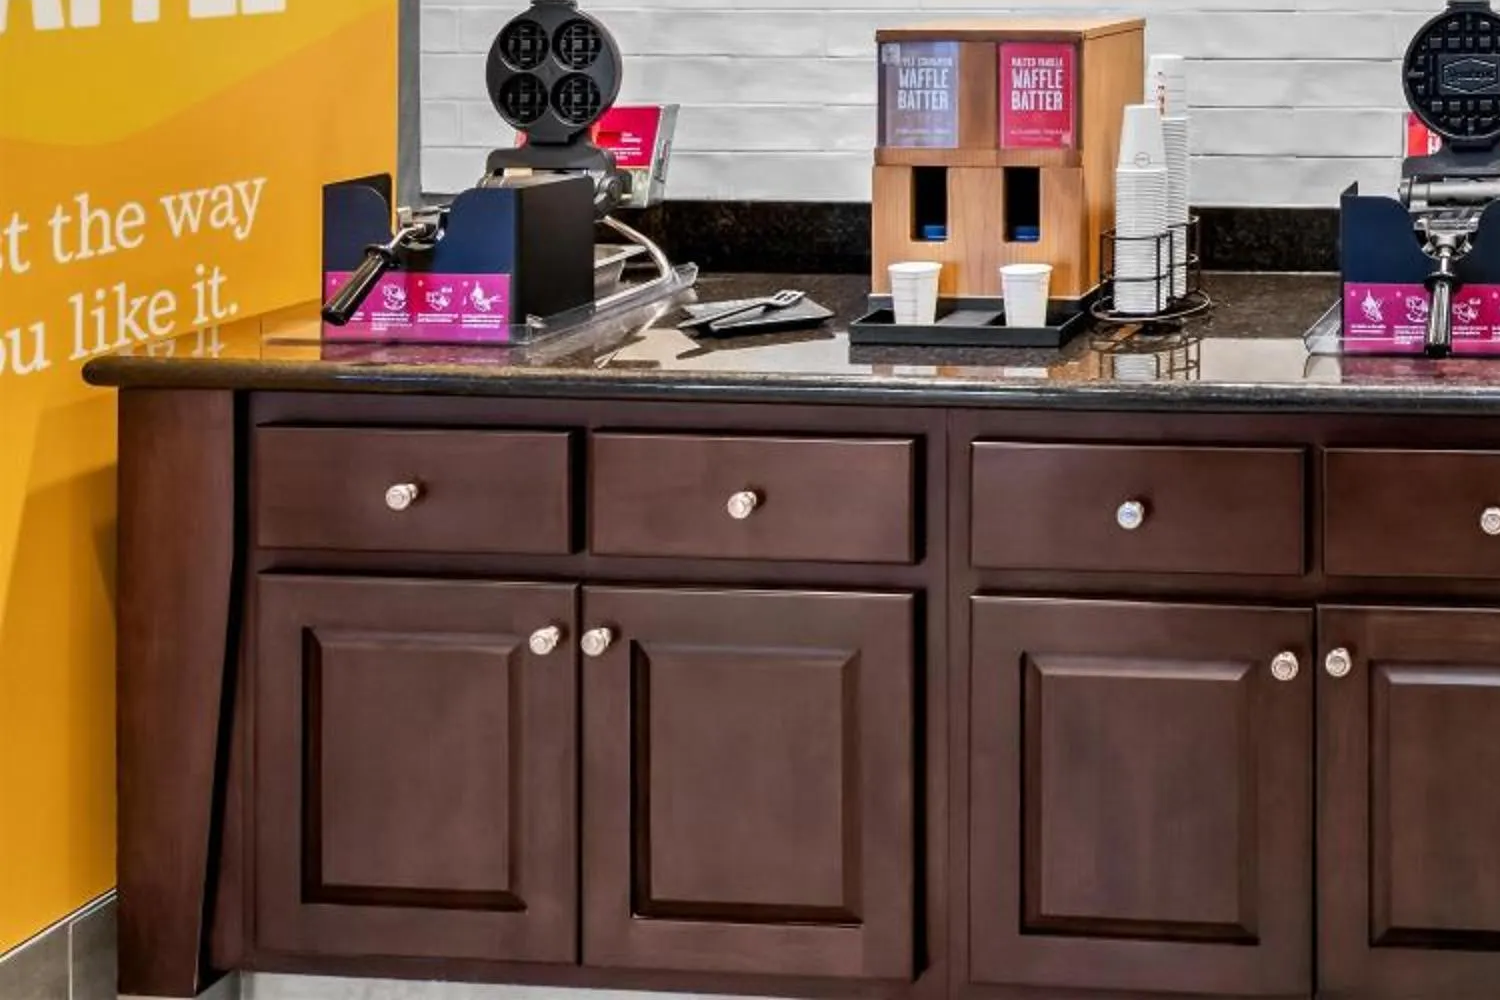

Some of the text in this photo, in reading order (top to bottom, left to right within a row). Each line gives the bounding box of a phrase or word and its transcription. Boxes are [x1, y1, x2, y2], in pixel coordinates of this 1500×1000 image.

[898, 67, 950, 89] WAFFLE
[1011, 67, 1064, 89] WAFFLE
[896, 89, 950, 111] BATTER
[1011, 89, 1064, 111] BATTER
[0, 176, 268, 274] t the way
[0, 263, 240, 376] u like it.
